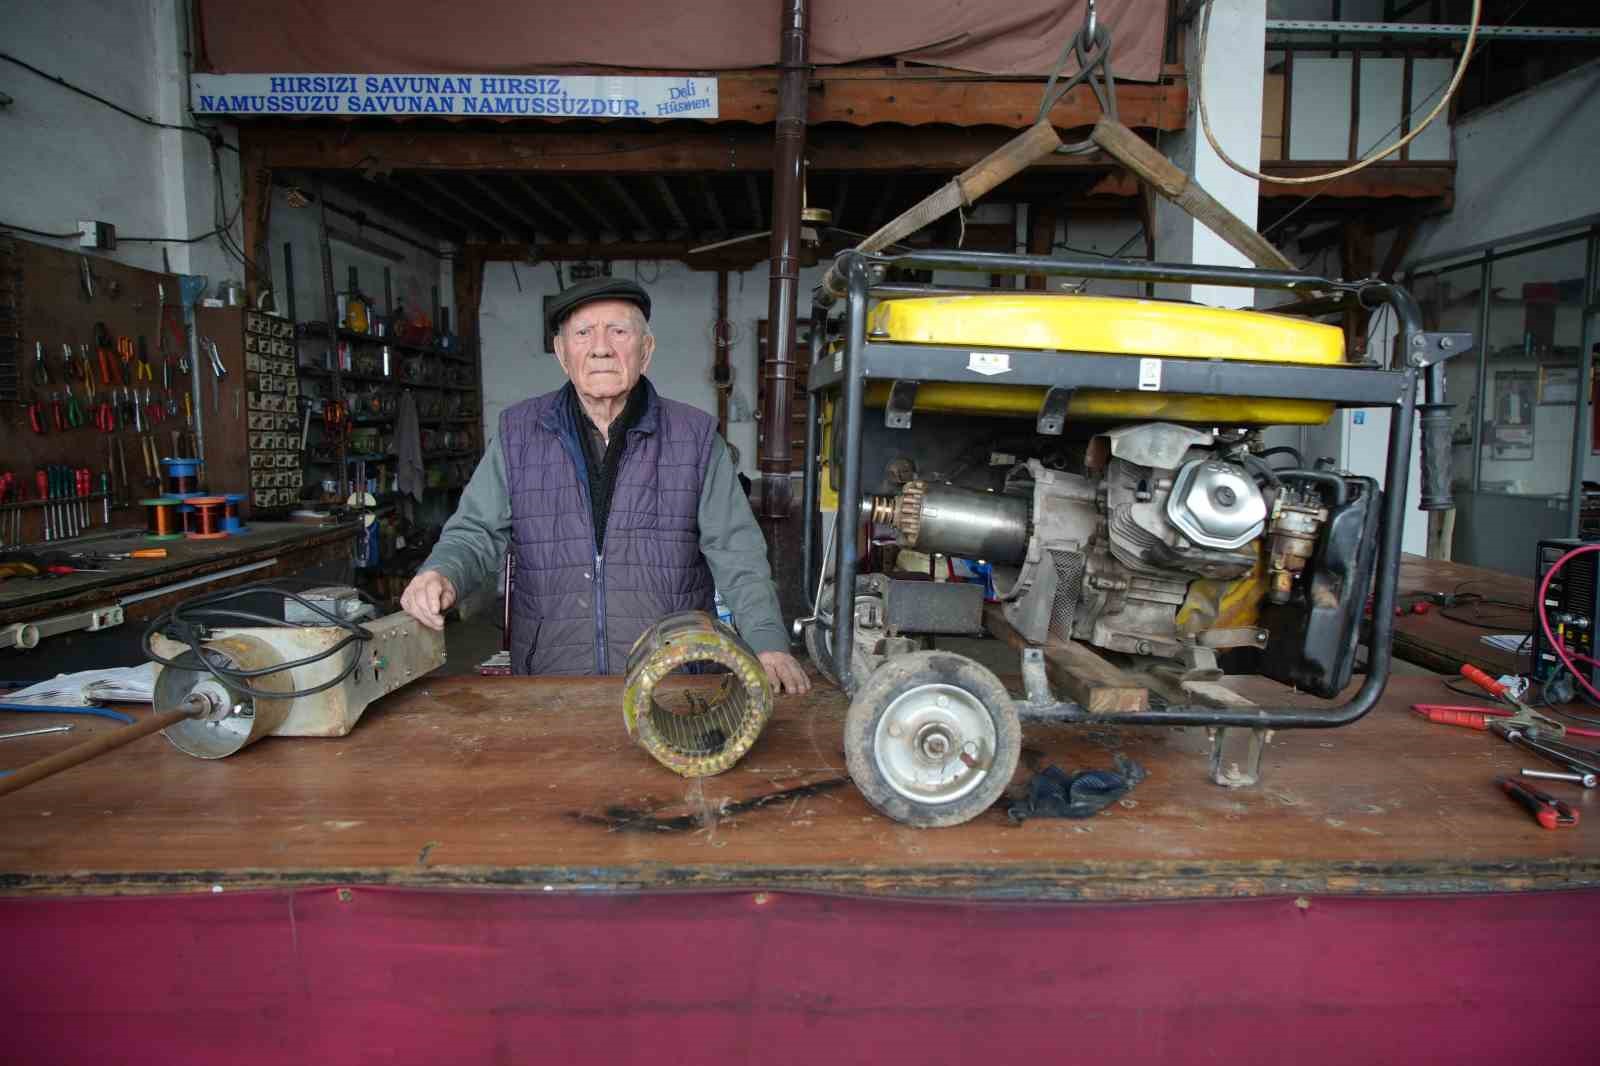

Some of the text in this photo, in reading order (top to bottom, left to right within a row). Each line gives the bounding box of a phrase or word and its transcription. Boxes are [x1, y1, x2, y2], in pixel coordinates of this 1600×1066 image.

[270, 77, 567, 97] HIRSIZI SAVUNAN HIRSIZ,
[669, 79, 696, 100] Deli
[200, 95, 647, 115] NAMUSSUZU SAVUNAN NAMUSSUZDUR.
